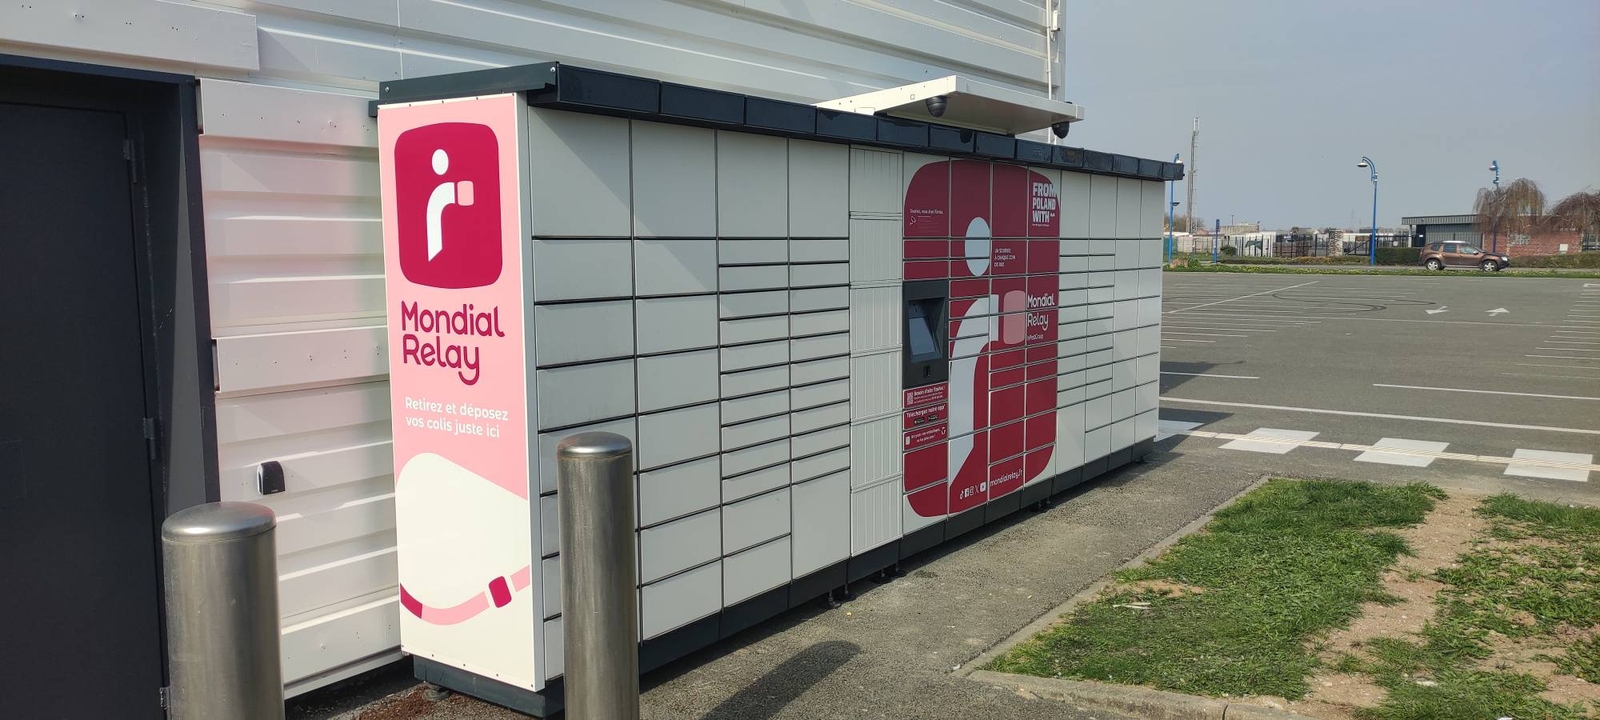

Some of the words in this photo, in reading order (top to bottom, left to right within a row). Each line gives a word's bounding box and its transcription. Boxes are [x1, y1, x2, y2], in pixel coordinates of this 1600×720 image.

[1032, 182, 1056, 197] FROM
[1032, 197, 1056, 210] POLAND
[1032, 210, 1050, 223] WITH
[1027, 293, 1055, 308] Mondial
[401, 300, 505, 338] Mondial
[1027, 312, 1049, 331] Relay
[402, 333, 480, 386] Relay
[405, 397, 443, 413] Retirez
[445, 403, 457, 415] et
[460, 403, 509, 421] déposez
[405, 416, 425, 428] vos
[427, 418, 452, 431] colis
[454, 419, 483, 436] juste
[486, 424, 500, 438] ici
